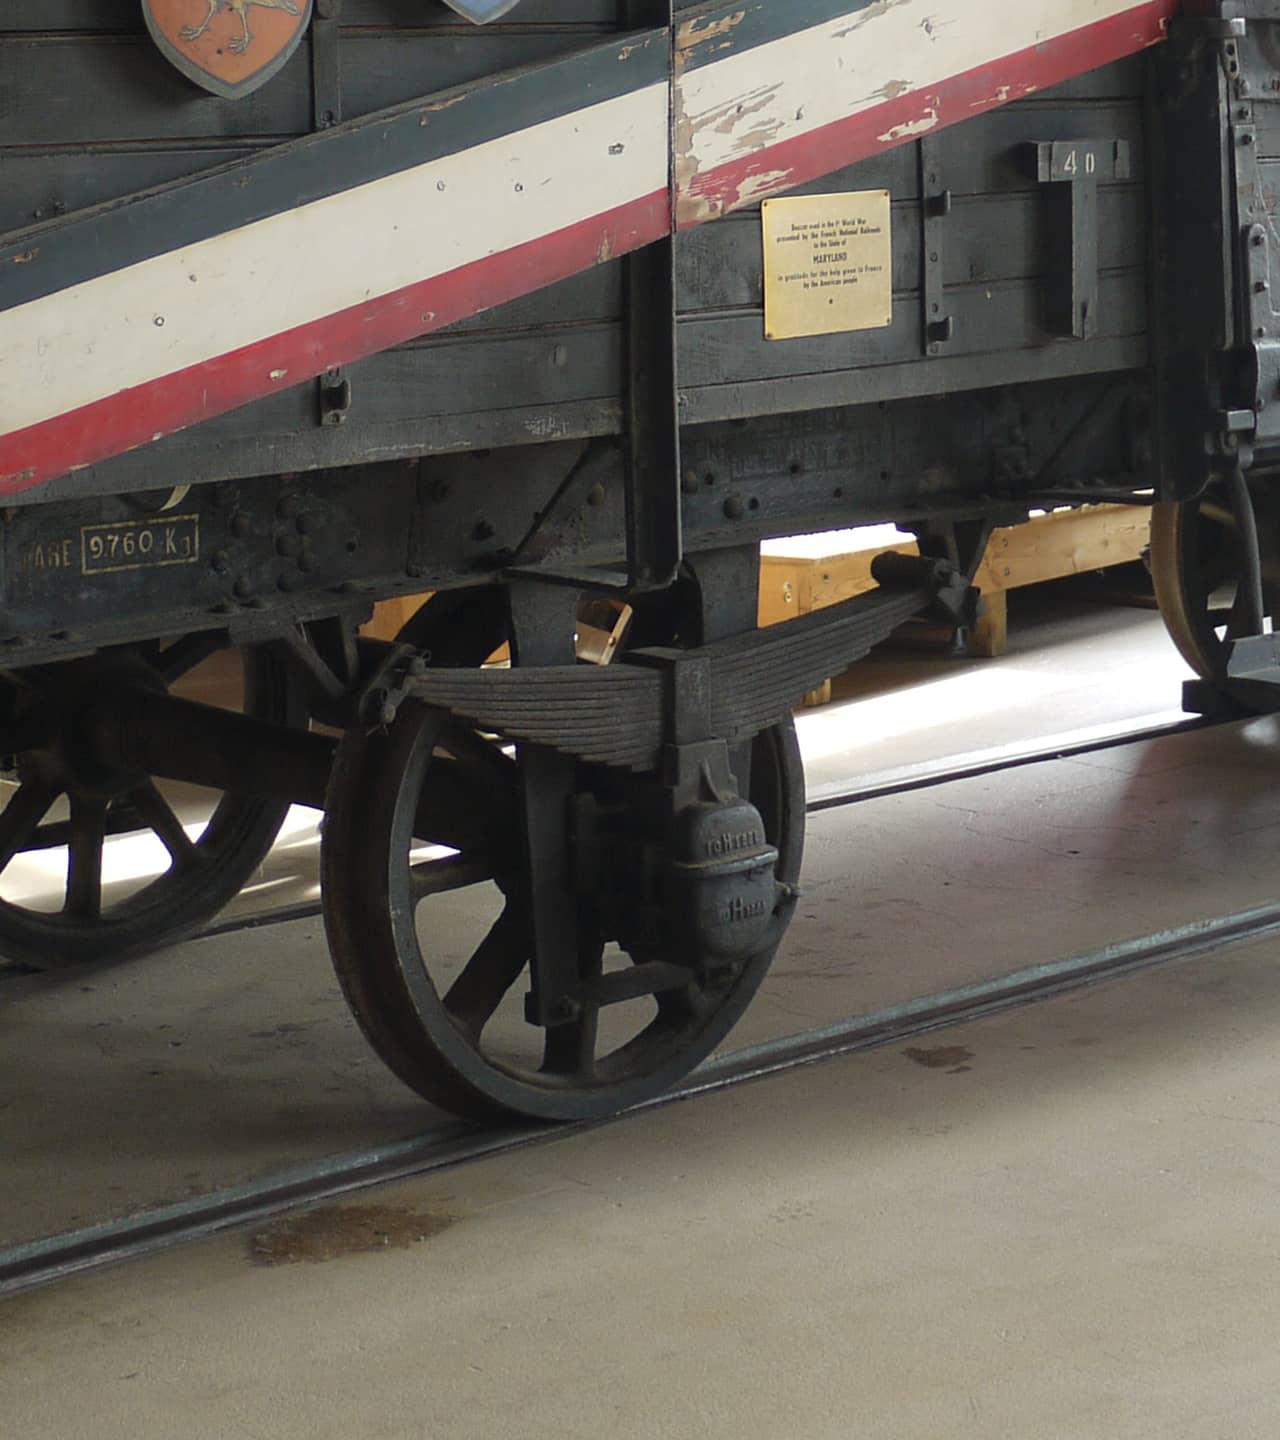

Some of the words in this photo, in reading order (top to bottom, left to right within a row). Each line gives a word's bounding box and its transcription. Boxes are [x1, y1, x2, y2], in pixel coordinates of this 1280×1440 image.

[1063, 149, 1096, 176] 40
[813, 252, 848, 265] MARYLAND
[88, 529, 154, 560] 9760
[164, 526, 192, 558] Kg
